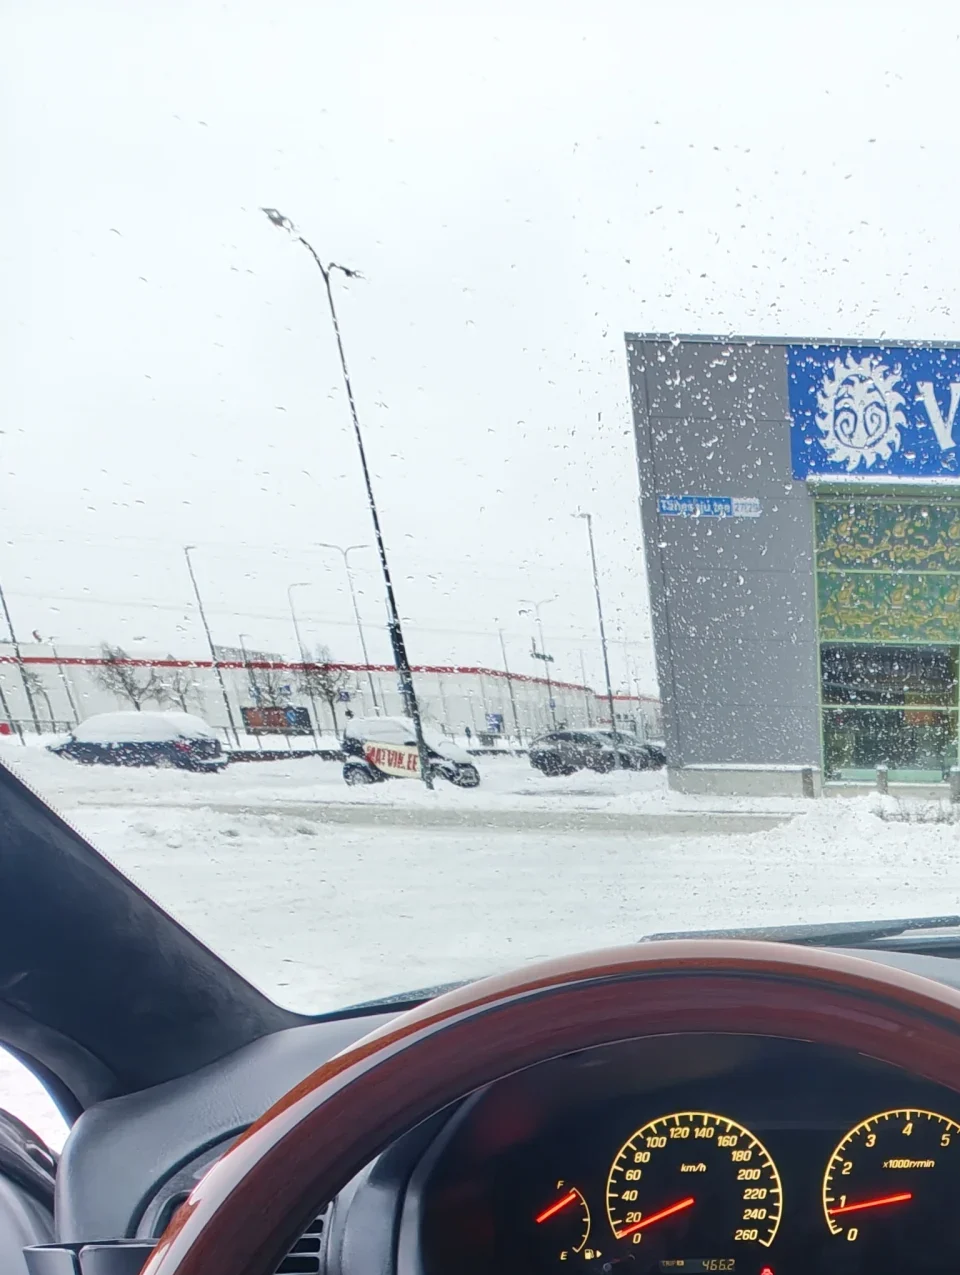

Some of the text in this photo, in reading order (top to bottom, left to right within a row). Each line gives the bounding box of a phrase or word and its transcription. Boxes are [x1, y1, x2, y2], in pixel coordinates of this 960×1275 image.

[669, 1127, 690, 1139] 120
[694, 1127, 714, 1139] 140
[902, 1123, 913, 1136] 4
[646, 1136, 667, 1148] 100
[717, 1135, 738, 1147] 160
[865, 1134, 877, 1147] 3
[940, 1134, 951, 1147] 5
[634, 1151, 651, 1163] 80
[731, 1150, 752, 1162] 180
[681, 1163, 706, 1173] km/h
[842, 1162, 853, 1175] 2
[625, 1169, 641, 1181] 60
[737, 1169, 761, 1180] 200
[556, 1180, 564, 1189] F
[622, 1190, 638, 1201] 40
[743, 1189, 768, 1199] 220
[839, 1195, 847, 1208] 1
[625, 1211, 642, 1223] 20
[743, 1208, 767, 1220] 240
[632, 1233, 642, 1244] 0
[734, 1229, 758, 1241] 260
[847, 1228, 858, 1241] 0
[560, 1252, 568, 1260] E
